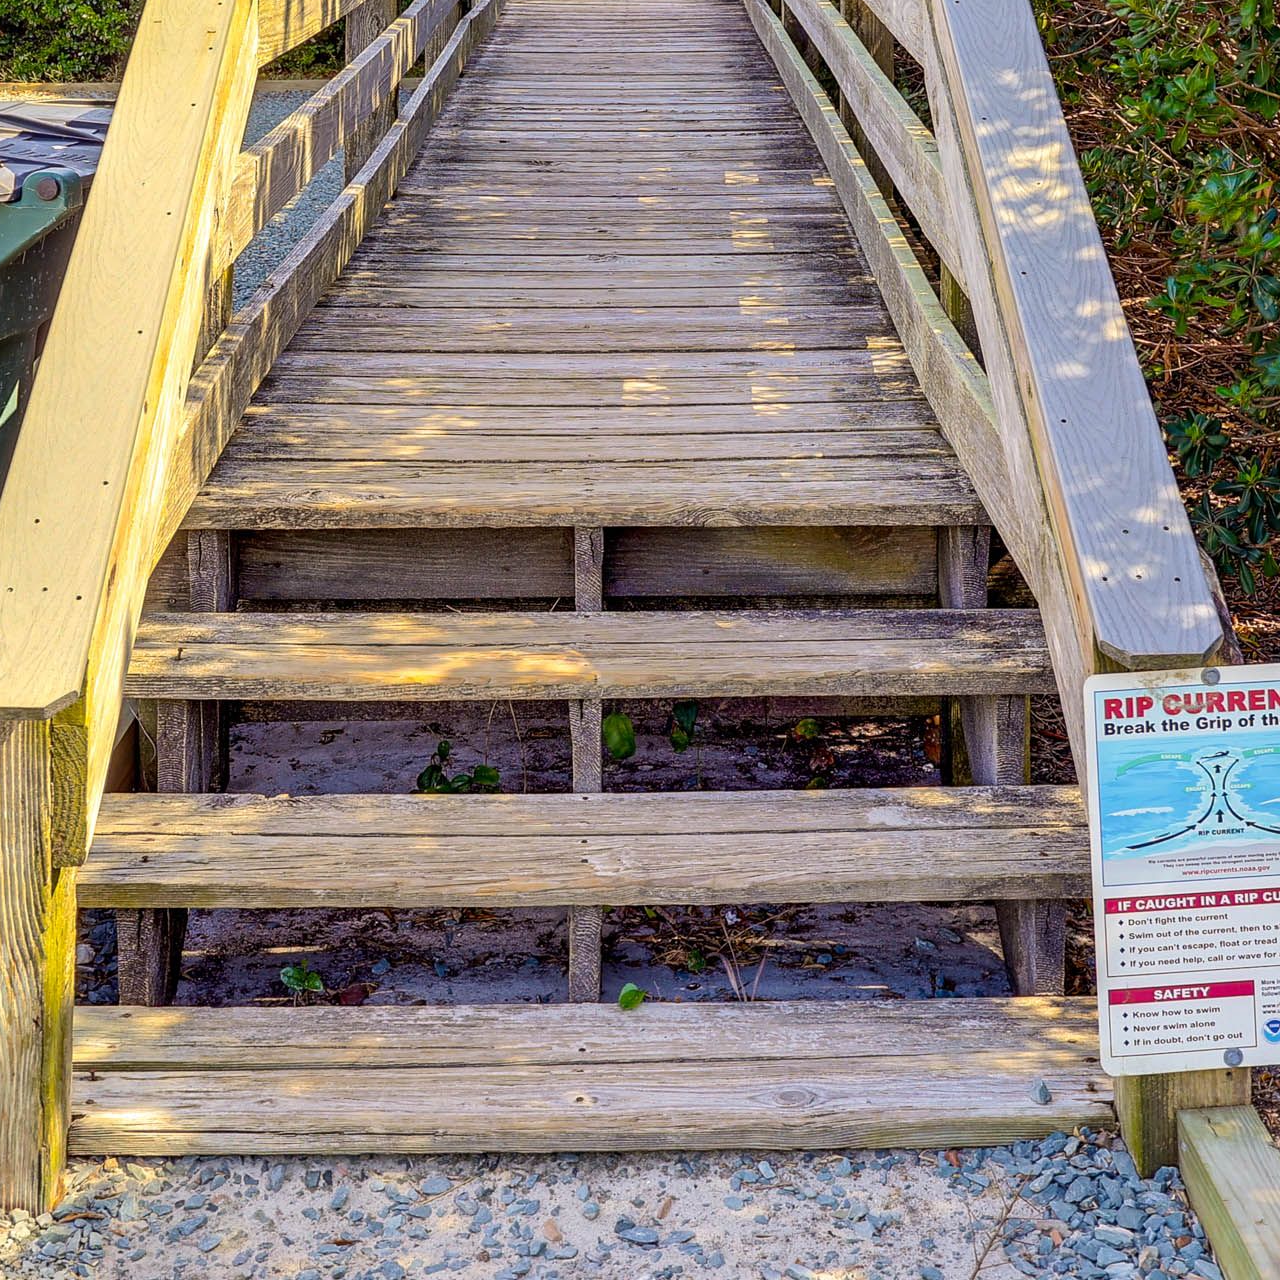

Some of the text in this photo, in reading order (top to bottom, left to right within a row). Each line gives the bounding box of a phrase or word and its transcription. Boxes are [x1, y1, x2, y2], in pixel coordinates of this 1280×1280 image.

[1104, 697, 1154, 720] RIP
[1104, 720, 1156, 735] Break
[1161, 718, 1190, 732] the
[1196, 716, 1232, 730] Grip
[1238, 714, 1255, 727] of
[1211, 827, 1244, 835] CURRENT
[1117, 900, 1131, 914] IF
[1135, 896, 1196, 912] CAUGHT
[1200, 895, 1216, 908] IN
[1219, 894, 1230, 907] A
[1234, 892, 1258, 906] RIP
[1128, 917, 1152, 926] Don't
[1154, 916, 1176, 925] fight
[1194, 913, 1228, 921] current
[1128, 932, 1154, 940] Swim
[1156, 930, 1171, 938] out
[1184, 928, 1199, 936] the
[1201, 926, 1237, 934] current,
[1137, 946, 1155, 954] you
[1157, 943, 1180, 951] can't
[1182, 942, 1217, 950] escape,
[1254, 937, 1277, 945] tread
[1138, 960, 1155, 968] you
[1157, 957, 1180, 965] need
[1182, 956, 1205, 964] help,
[1207, 954, 1223, 962] call
[1153, 987, 1210, 1001] SAFETY
[1196, 1006, 1220, 1014] swim
[1162, 1022, 1187, 1030] swim
[1190, 1020, 1215, 1028] alone
[1133, 1038, 1140, 1046] If
[1153, 1036, 1183, 1044] doubt,
[1186, 1034, 1210, 1042] don't
[1212, 1034, 1225, 1042] go
